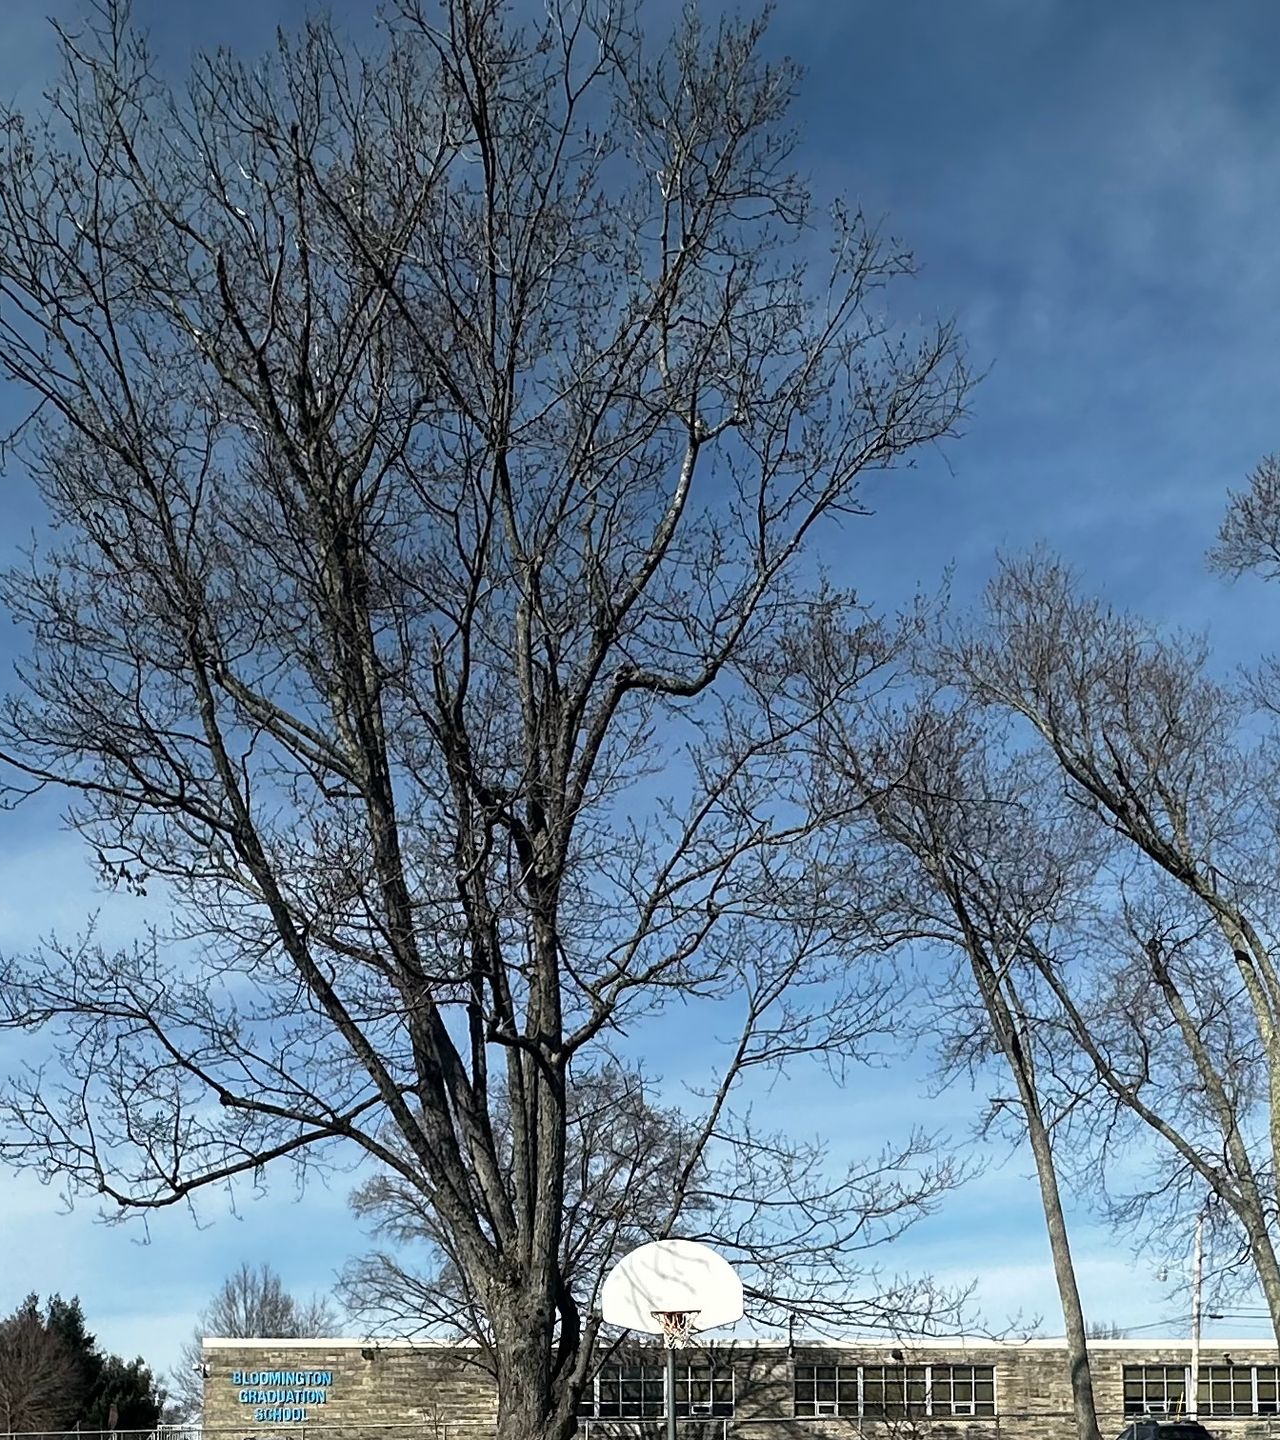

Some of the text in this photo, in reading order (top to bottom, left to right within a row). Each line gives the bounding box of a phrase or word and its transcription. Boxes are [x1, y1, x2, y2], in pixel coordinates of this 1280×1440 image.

[232, 1371, 333, 1387] BLOOMINGTON
[238, 1389, 326, 1404] GRADUATION
[255, 1407, 309, 1422] SCHOOL
